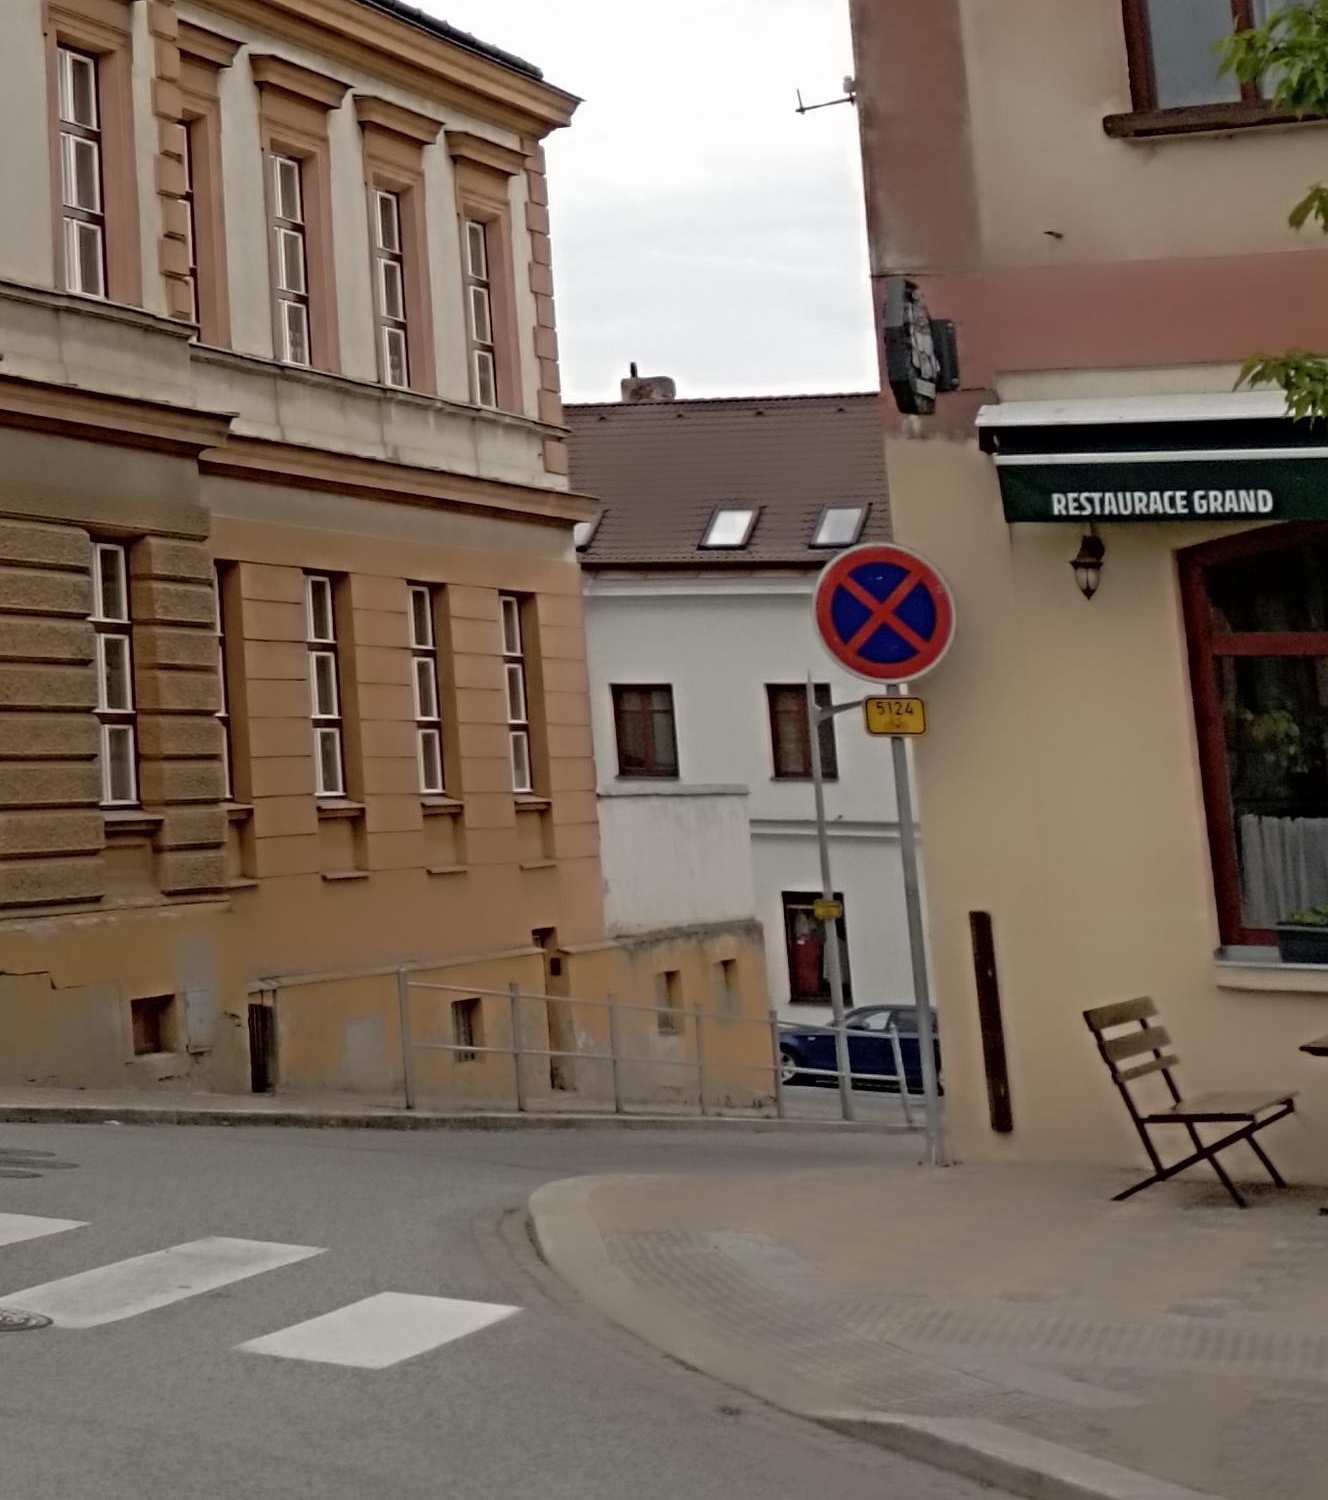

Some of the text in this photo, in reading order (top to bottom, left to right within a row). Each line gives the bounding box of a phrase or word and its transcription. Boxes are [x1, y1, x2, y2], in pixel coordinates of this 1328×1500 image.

[1052, 489, 1273, 515] RESTAURACE GRAND
[876, 701, 914, 716] 5124
